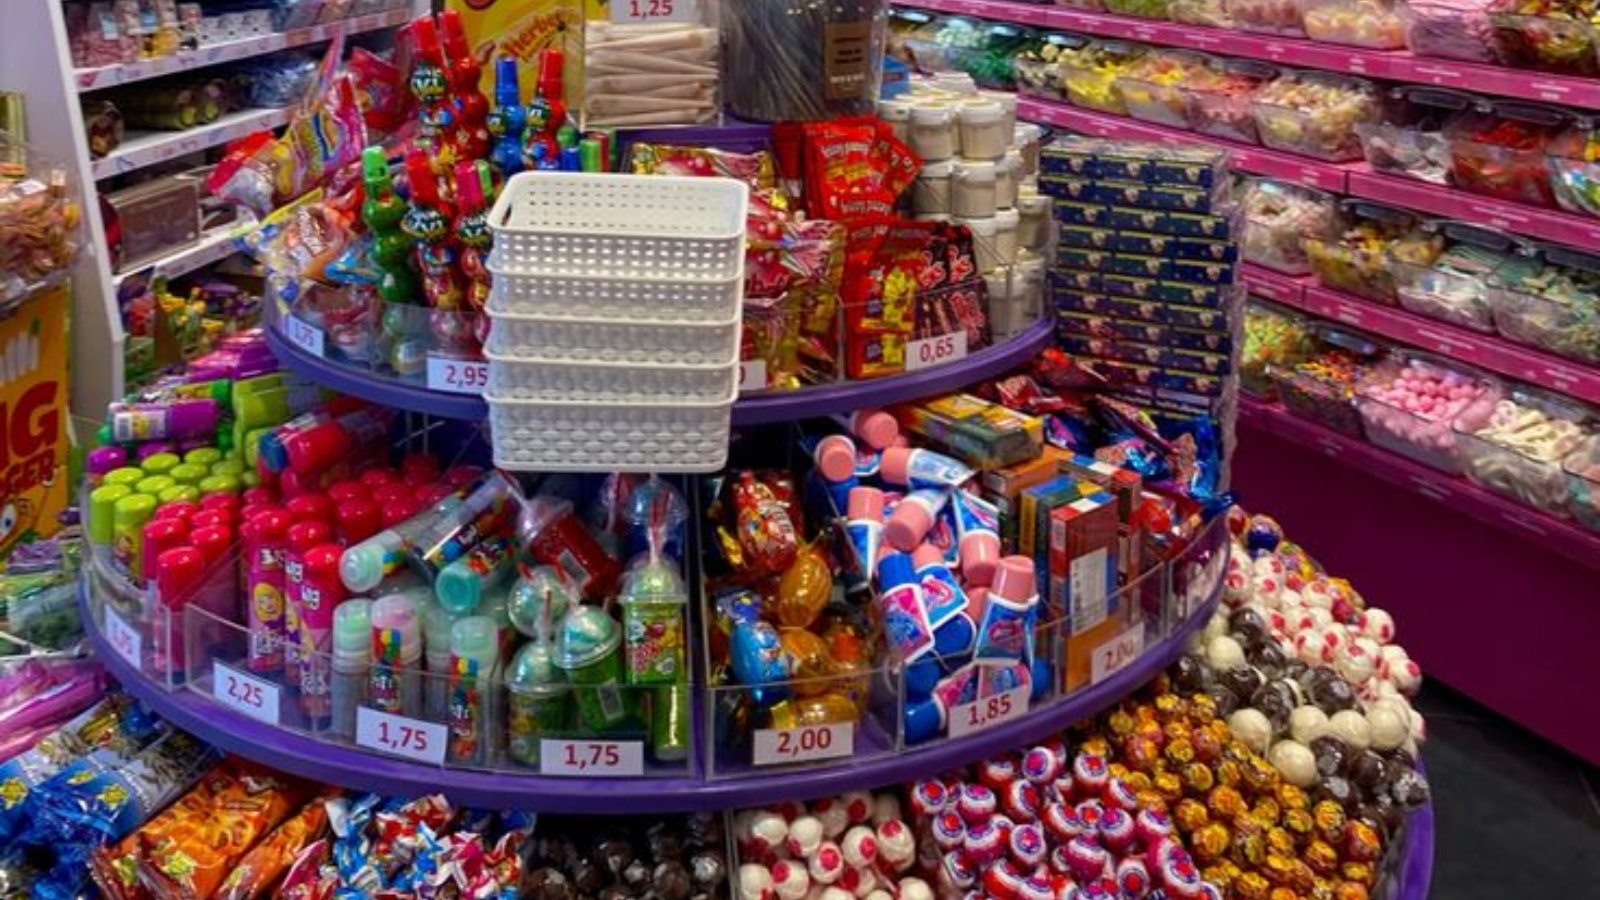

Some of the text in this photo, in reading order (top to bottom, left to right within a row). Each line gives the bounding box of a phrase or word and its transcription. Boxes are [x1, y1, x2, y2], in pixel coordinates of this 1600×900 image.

[631, 0, 672, 18] 1,25
[920, 337, 954, 362] 0,65
[445, 365, 489, 388] 2,95
[227, 676, 264, 708] 2,25
[967, 695, 1012, 726] 1,85
[378, 722, 428, 750] 1,75
[777, 728, 831, 754] 2,00
[564, 745, 618, 769] 1,75
